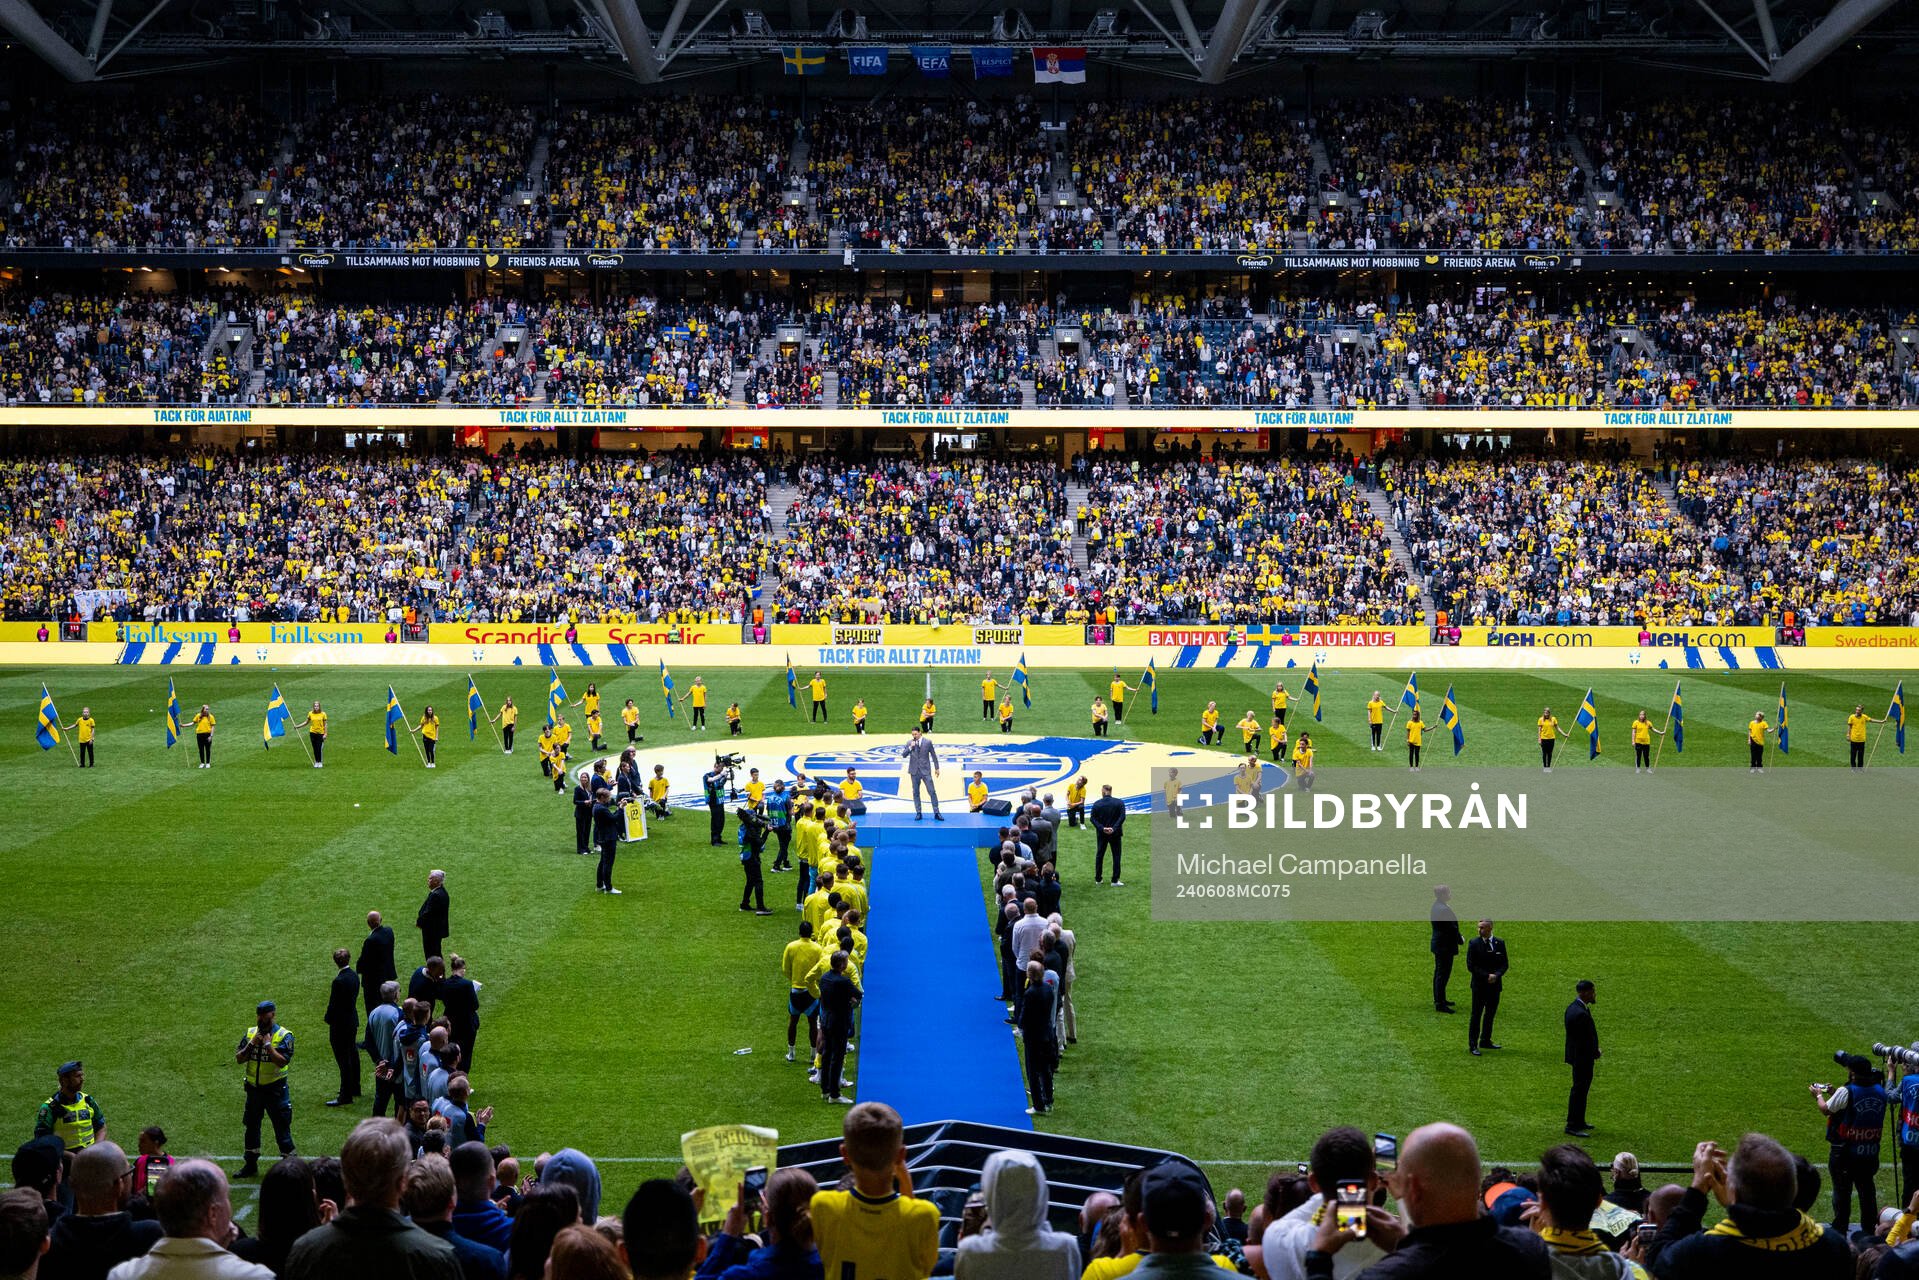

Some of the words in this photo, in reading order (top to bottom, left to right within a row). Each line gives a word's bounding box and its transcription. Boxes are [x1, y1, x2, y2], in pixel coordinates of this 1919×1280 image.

[853, 56, 882, 67] FIFA
[304, 256, 328, 265] friends
[346, 256, 410, 266] TILLSAMMANS
[412, 256, 431, 266] MOT
[433, 256, 480, 266] MOBBNING
[508, 257, 546, 267] FRIENDS
[549, 257, 580, 267] ARENA
[592, 257, 618, 266] friends
[1242, 258, 1267, 267] friends
[1284, 258, 1348, 267] TILLSAMMANS
[1351, 258, 1370, 267] MOT
[1372, 258, 1420, 267] MOBBNING
[1444, 258, 1482, 267] FRIENDS
[1485, 258, 1516, 267] ARENA
[154, 410, 182, 422] TACK
[184, 409, 204, 422] FÖR
[500, 411, 528, 423] TACK
[531, 410, 550, 423] FÖR
[554, 411, 578, 423] ALLT
[582, 411, 626, 423] ZLATAN!
[882, 412, 910, 424] TACK
[913, 411, 933, 424] FÖR
[936, 412, 960, 424] ALLT
[964, 412, 1009, 424] ZLATAN!
[1255, 413, 1283, 424] TACK
[1286, 412, 1306, 424] FÖR
[1604, 413, 1633, 425] TACK
[1635, 412, 1656, 425] FÖR
[1659, 413, 1684, 425] ALLT
[1687, 413, 1732, 425] ZLATAN!
[126, 626, 218, 642] Folksam
[271, 626, 363, 643] Folksam
[465, 627, 562, 644] Scandic
[835, 629, 881, 644] SPORT
[975, 629, 1022, 644] SPORT
[1299, 633, 1394, 646] BAUHAUS
[1835, 634, 1918, 647] Swedbank
[818, 648, 854, 664] TACK
[858, 647, 885, 664] FÖR
[888, 649, 921, 664] ALLT
[924, 649, 981, 664] ZLATAN!
